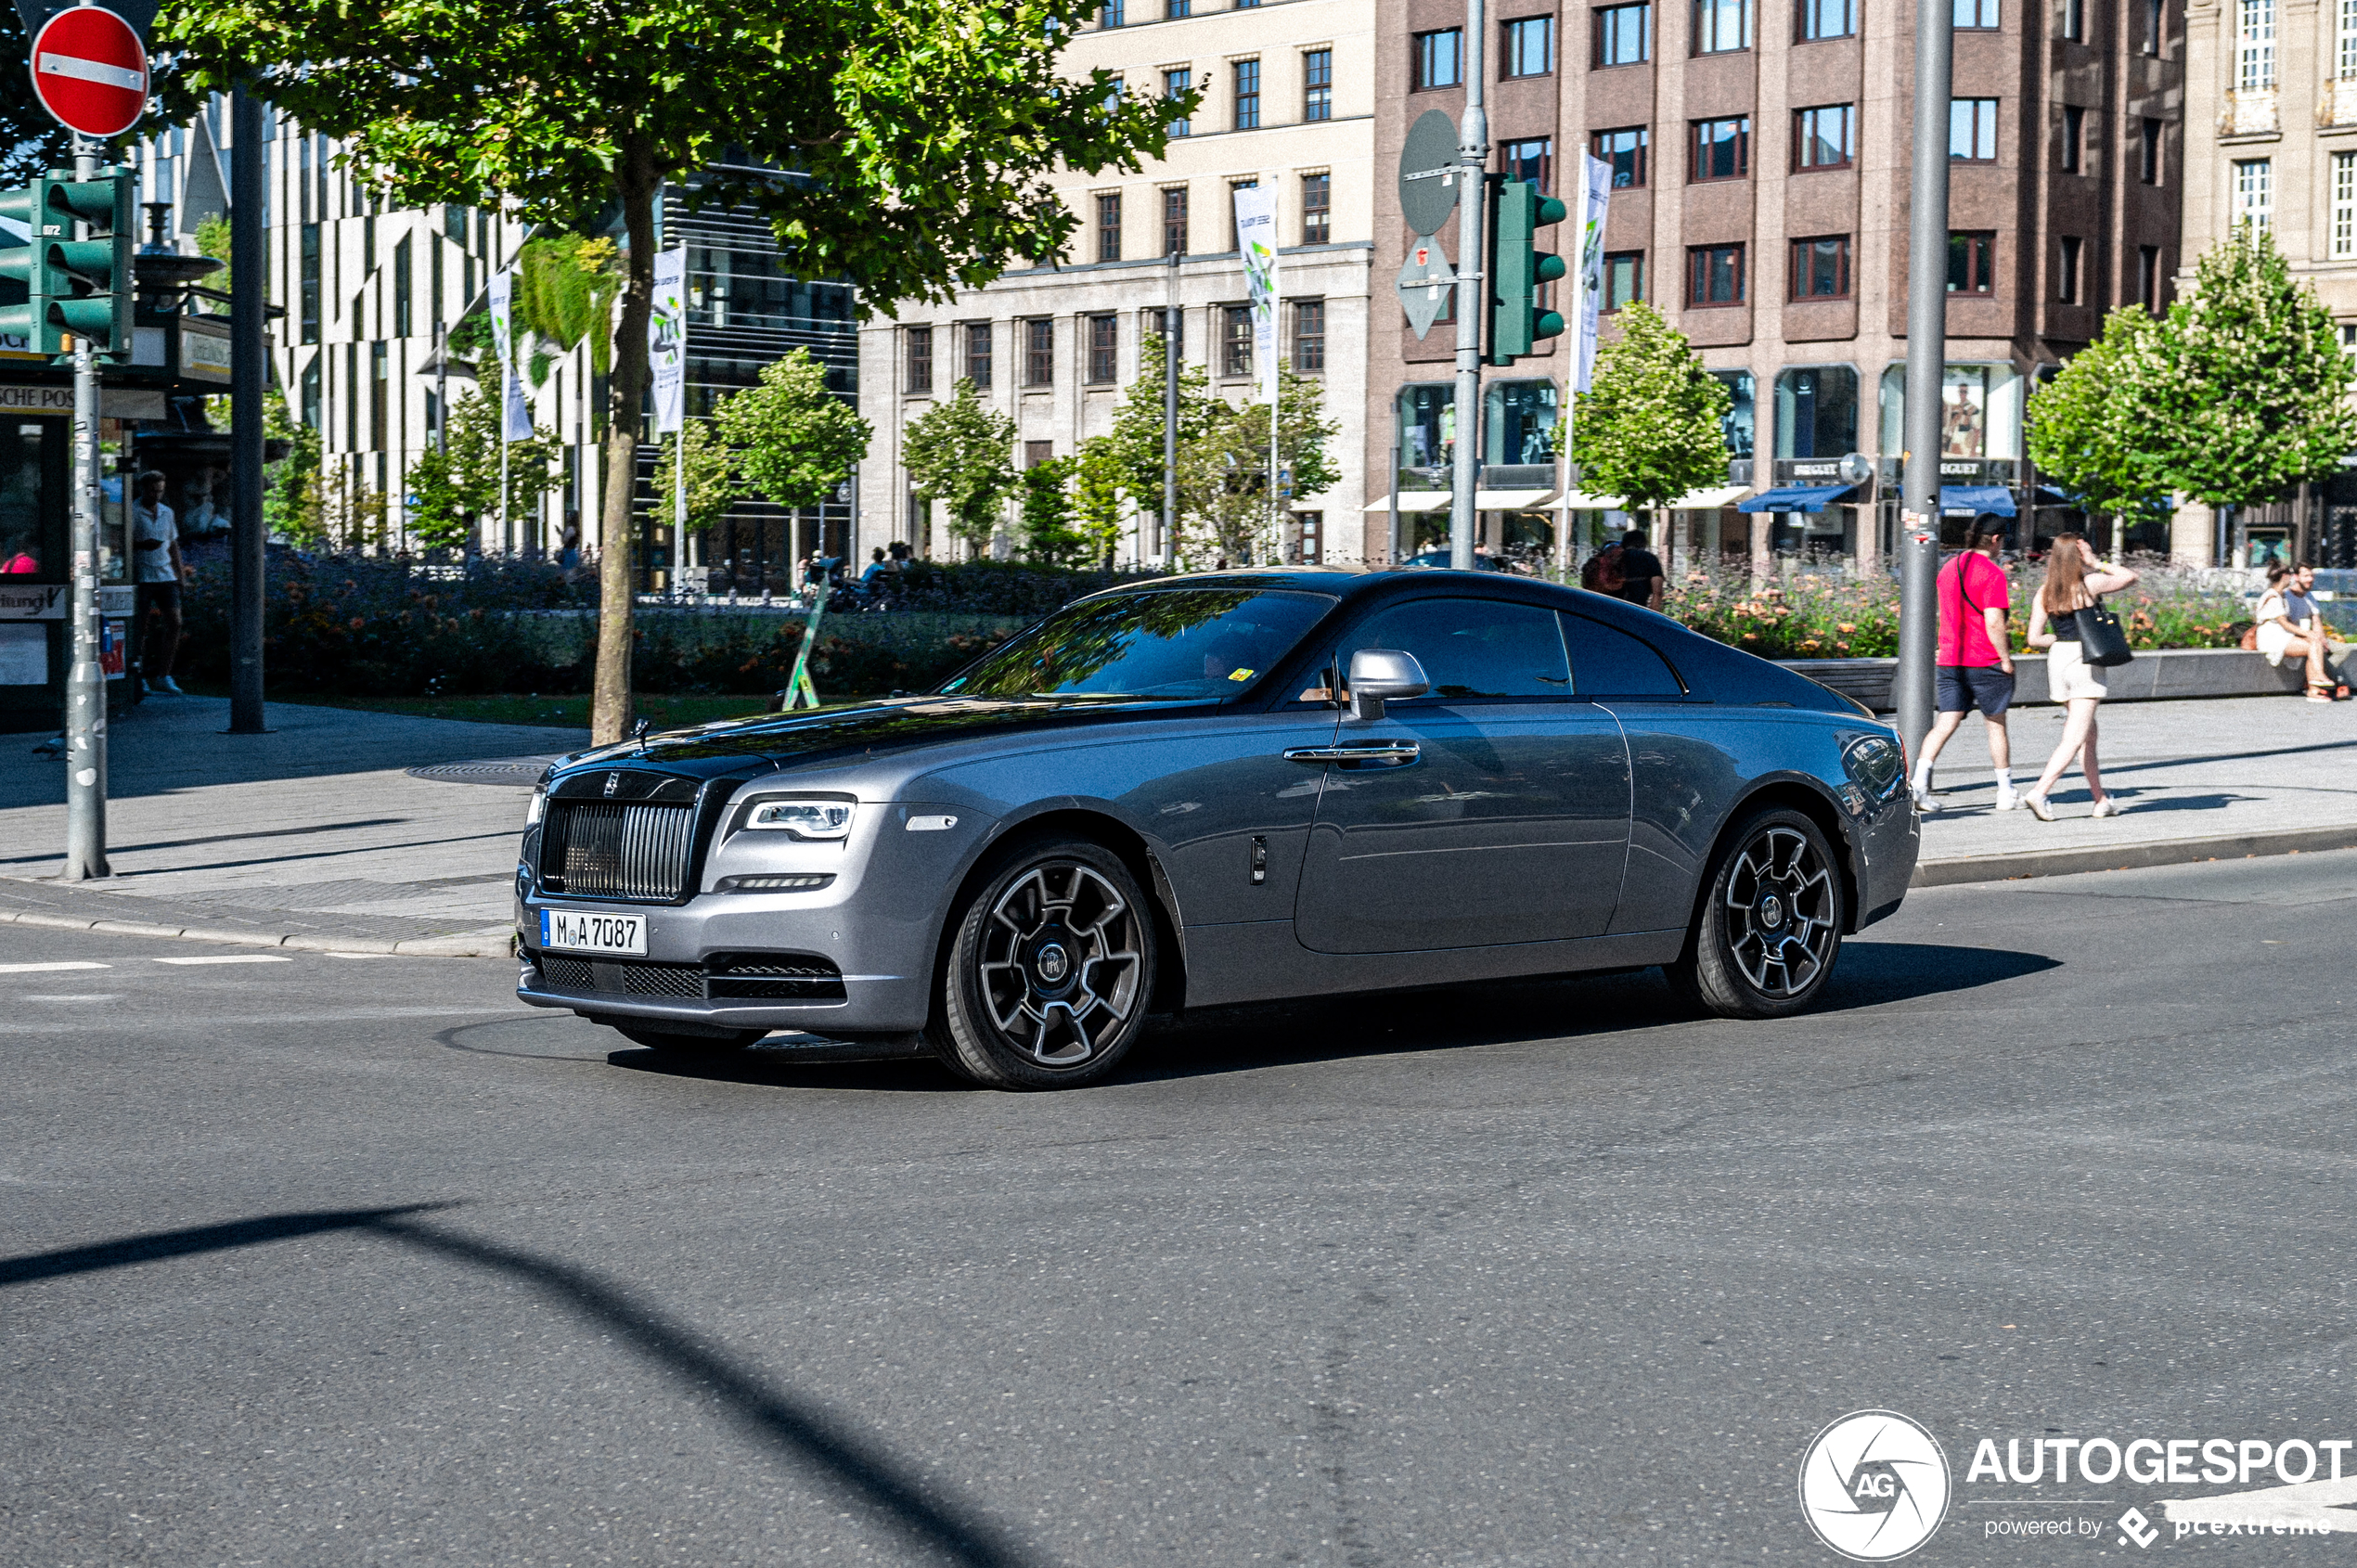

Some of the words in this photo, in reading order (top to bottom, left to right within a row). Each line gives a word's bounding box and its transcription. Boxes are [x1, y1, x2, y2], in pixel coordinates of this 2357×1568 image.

[42, 390, 74, 408] POS
[557, 915, 567, 944] M
[578, 917, 587, 945] A
[592, 918, 637, 947] 7087
